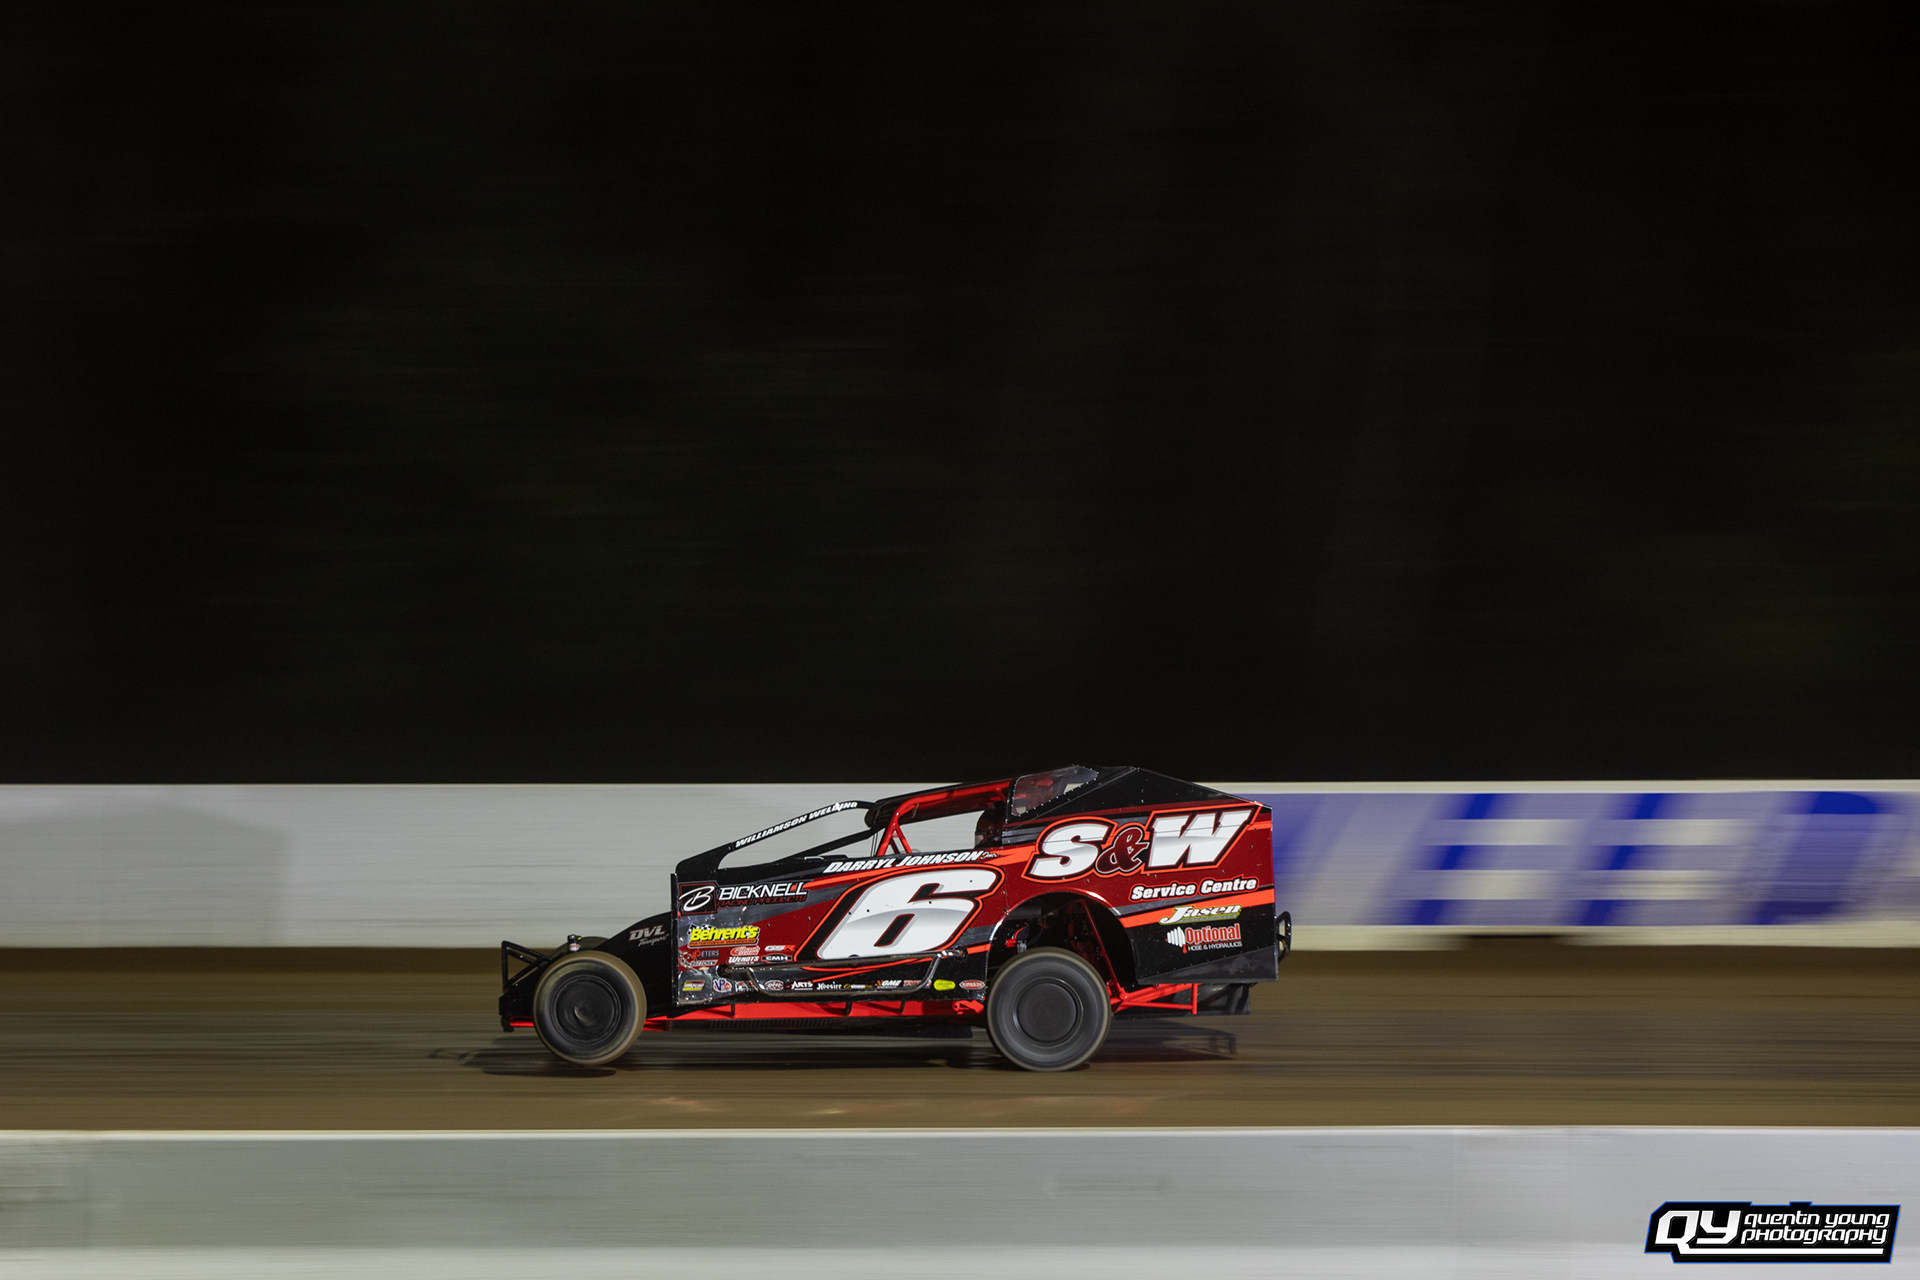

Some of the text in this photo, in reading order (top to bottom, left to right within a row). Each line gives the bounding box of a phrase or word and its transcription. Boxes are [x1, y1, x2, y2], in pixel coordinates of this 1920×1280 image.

[735, 802, 858, 848] WILLIAMSON WELDING
[1030, 809, 1252, 877] S&W
[823, 858, 897, 873] DARRYL
[895, 850, 984, 867] JOHNSON
[719, 882, 807, 901] BICKNELL
[1131, 878, 1257, 900] Service Centre
[717, 895, 807, 907] RACING PRODUCTS
[817, 869, 996, 960] 6
[629, 925, 665, 941] DVL
[689, 926, 758, 941] Behrent's
[1185, 923, 1241, 945] Optional
[1208, 941, 1242, 950] HYDRAULICS
[817, 981, 842, 990] Hoosier
